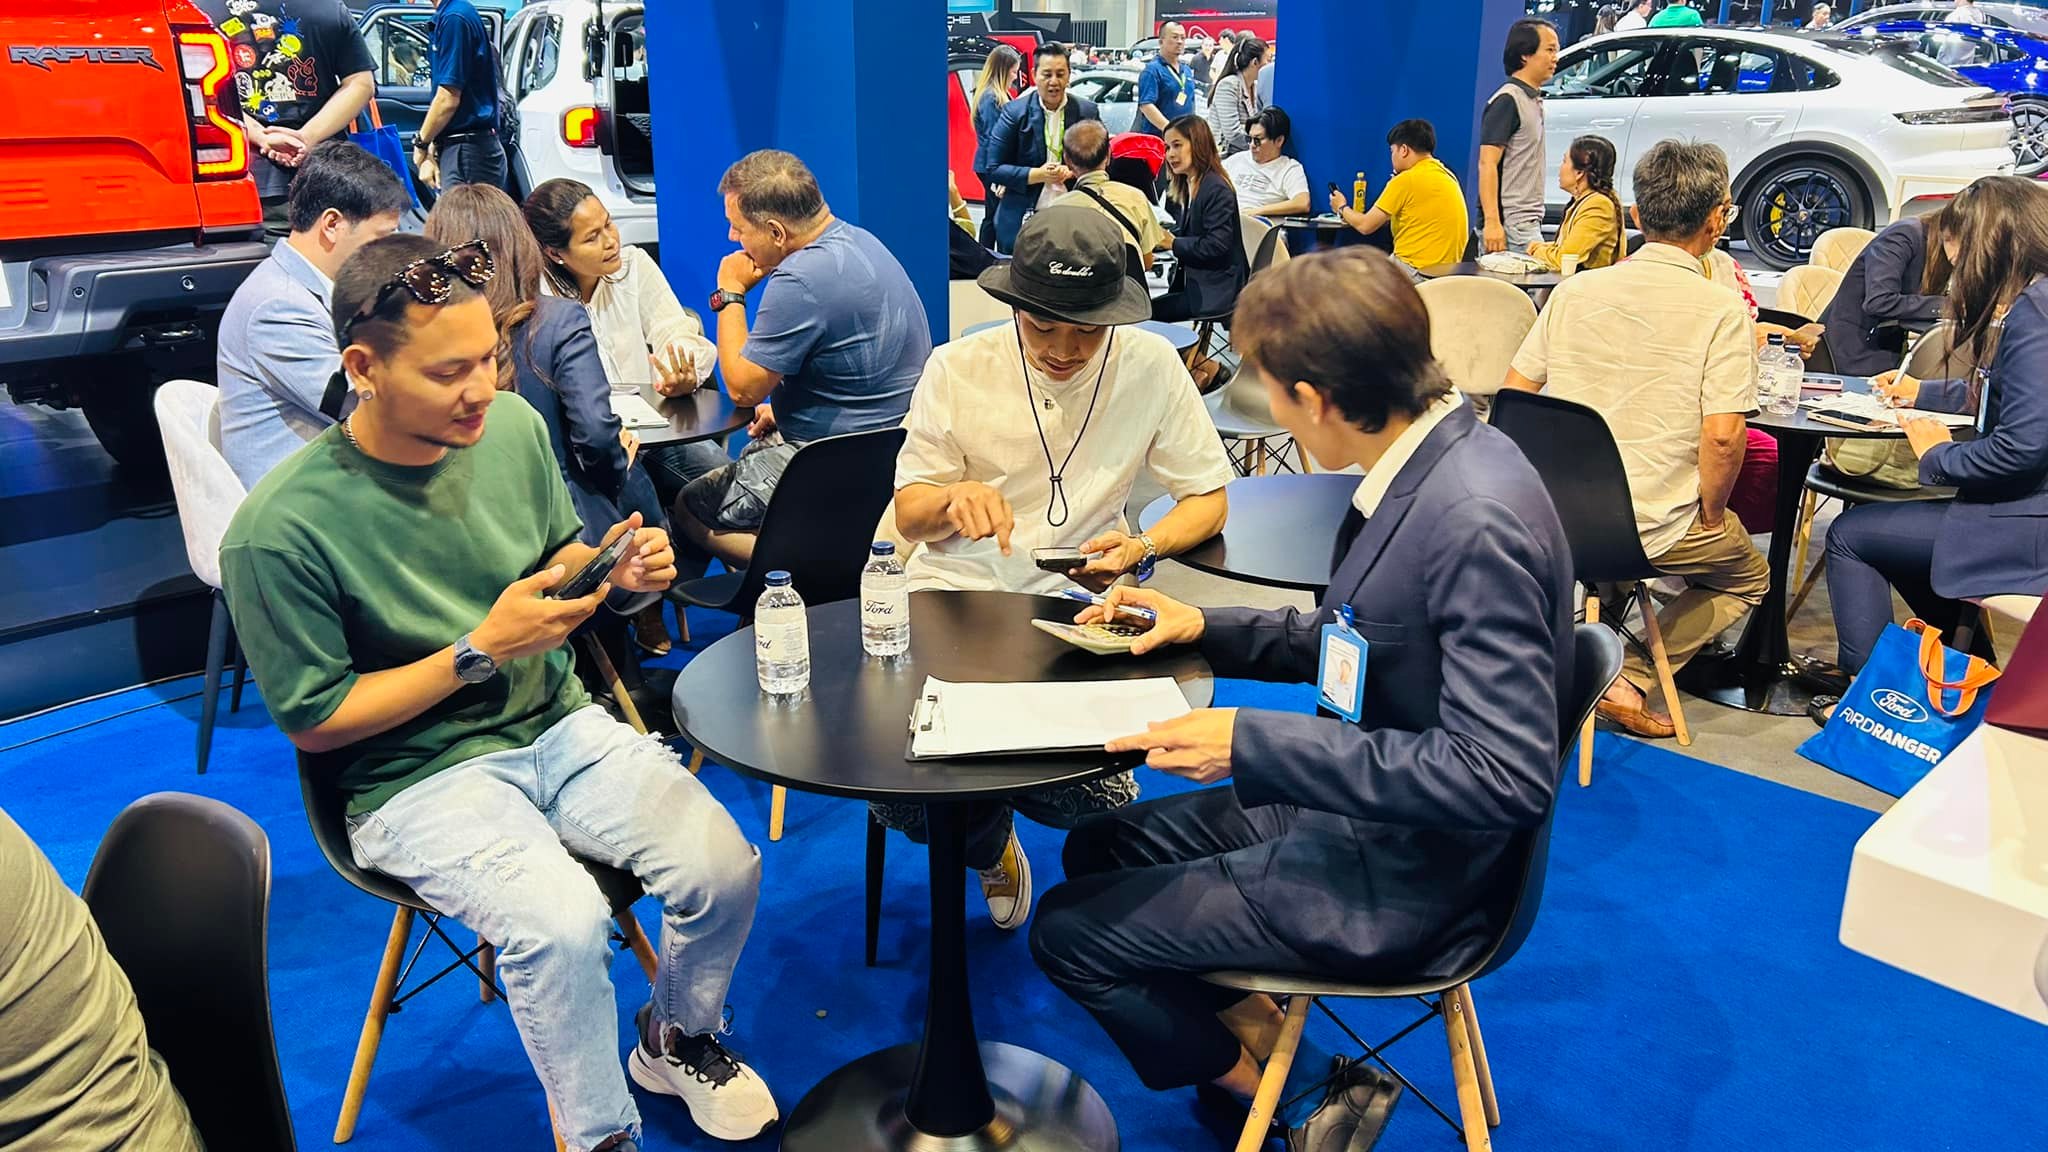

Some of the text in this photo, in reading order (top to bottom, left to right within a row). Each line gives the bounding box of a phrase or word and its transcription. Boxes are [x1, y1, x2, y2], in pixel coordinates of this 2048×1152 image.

[9, 46, 164, 72] RAPTOR
[865, 600, 894, 615] Ford
[1878, 691, 1919, 719] Ford
